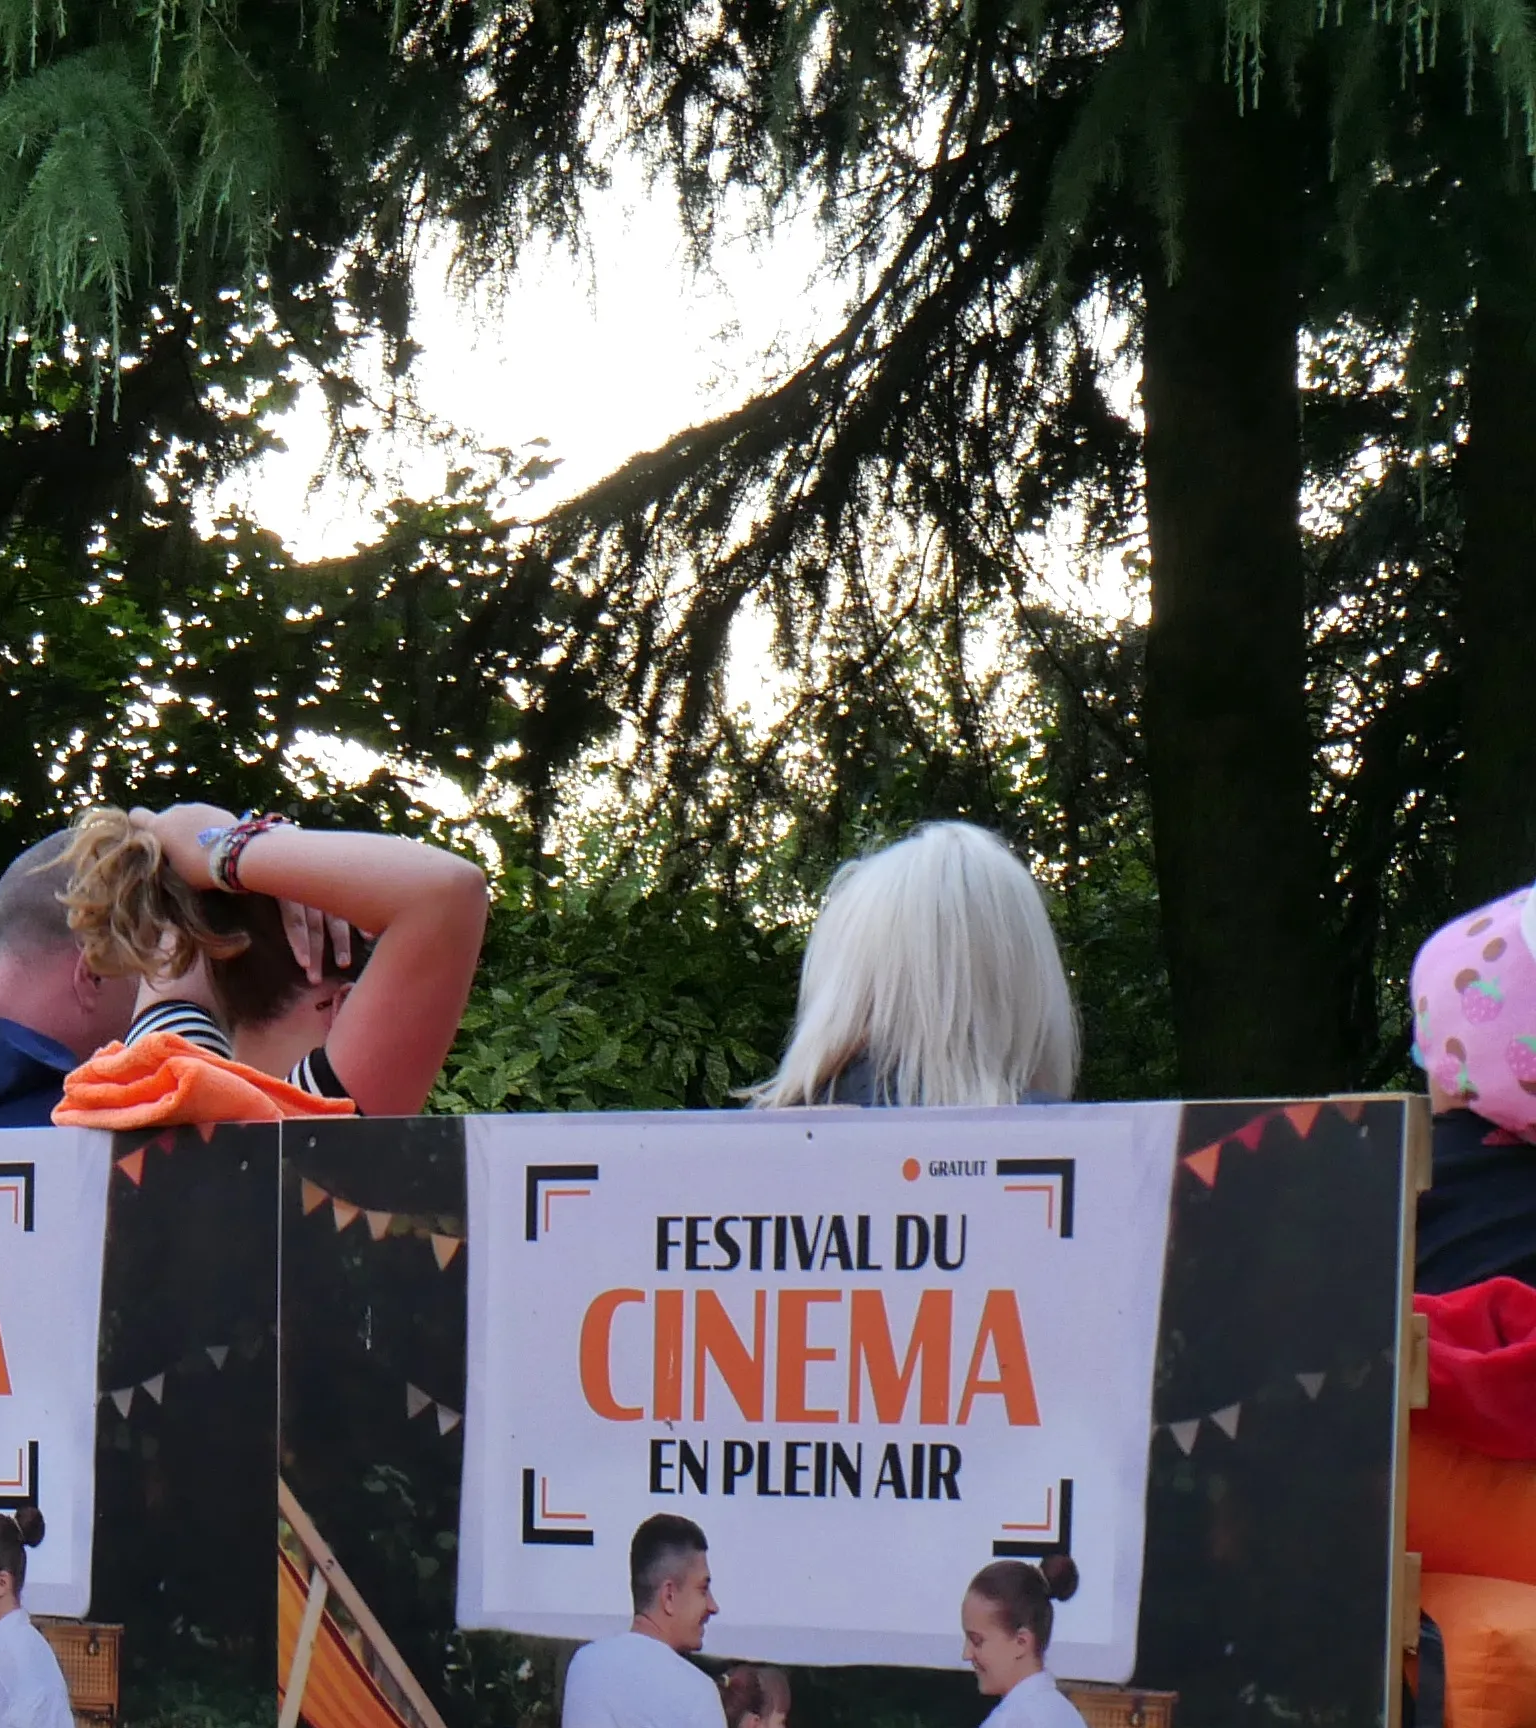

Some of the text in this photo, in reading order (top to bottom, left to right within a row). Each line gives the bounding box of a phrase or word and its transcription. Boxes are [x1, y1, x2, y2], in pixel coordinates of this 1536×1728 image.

[928, 1160, 988, 1178] GRATUIT
[655, 1213, 967, 1271] FESTIVAL DU
[578, 1288, 1042, 1427] CINEMA
[649, 1438, 962, 1501] EN PLEIN AIR
